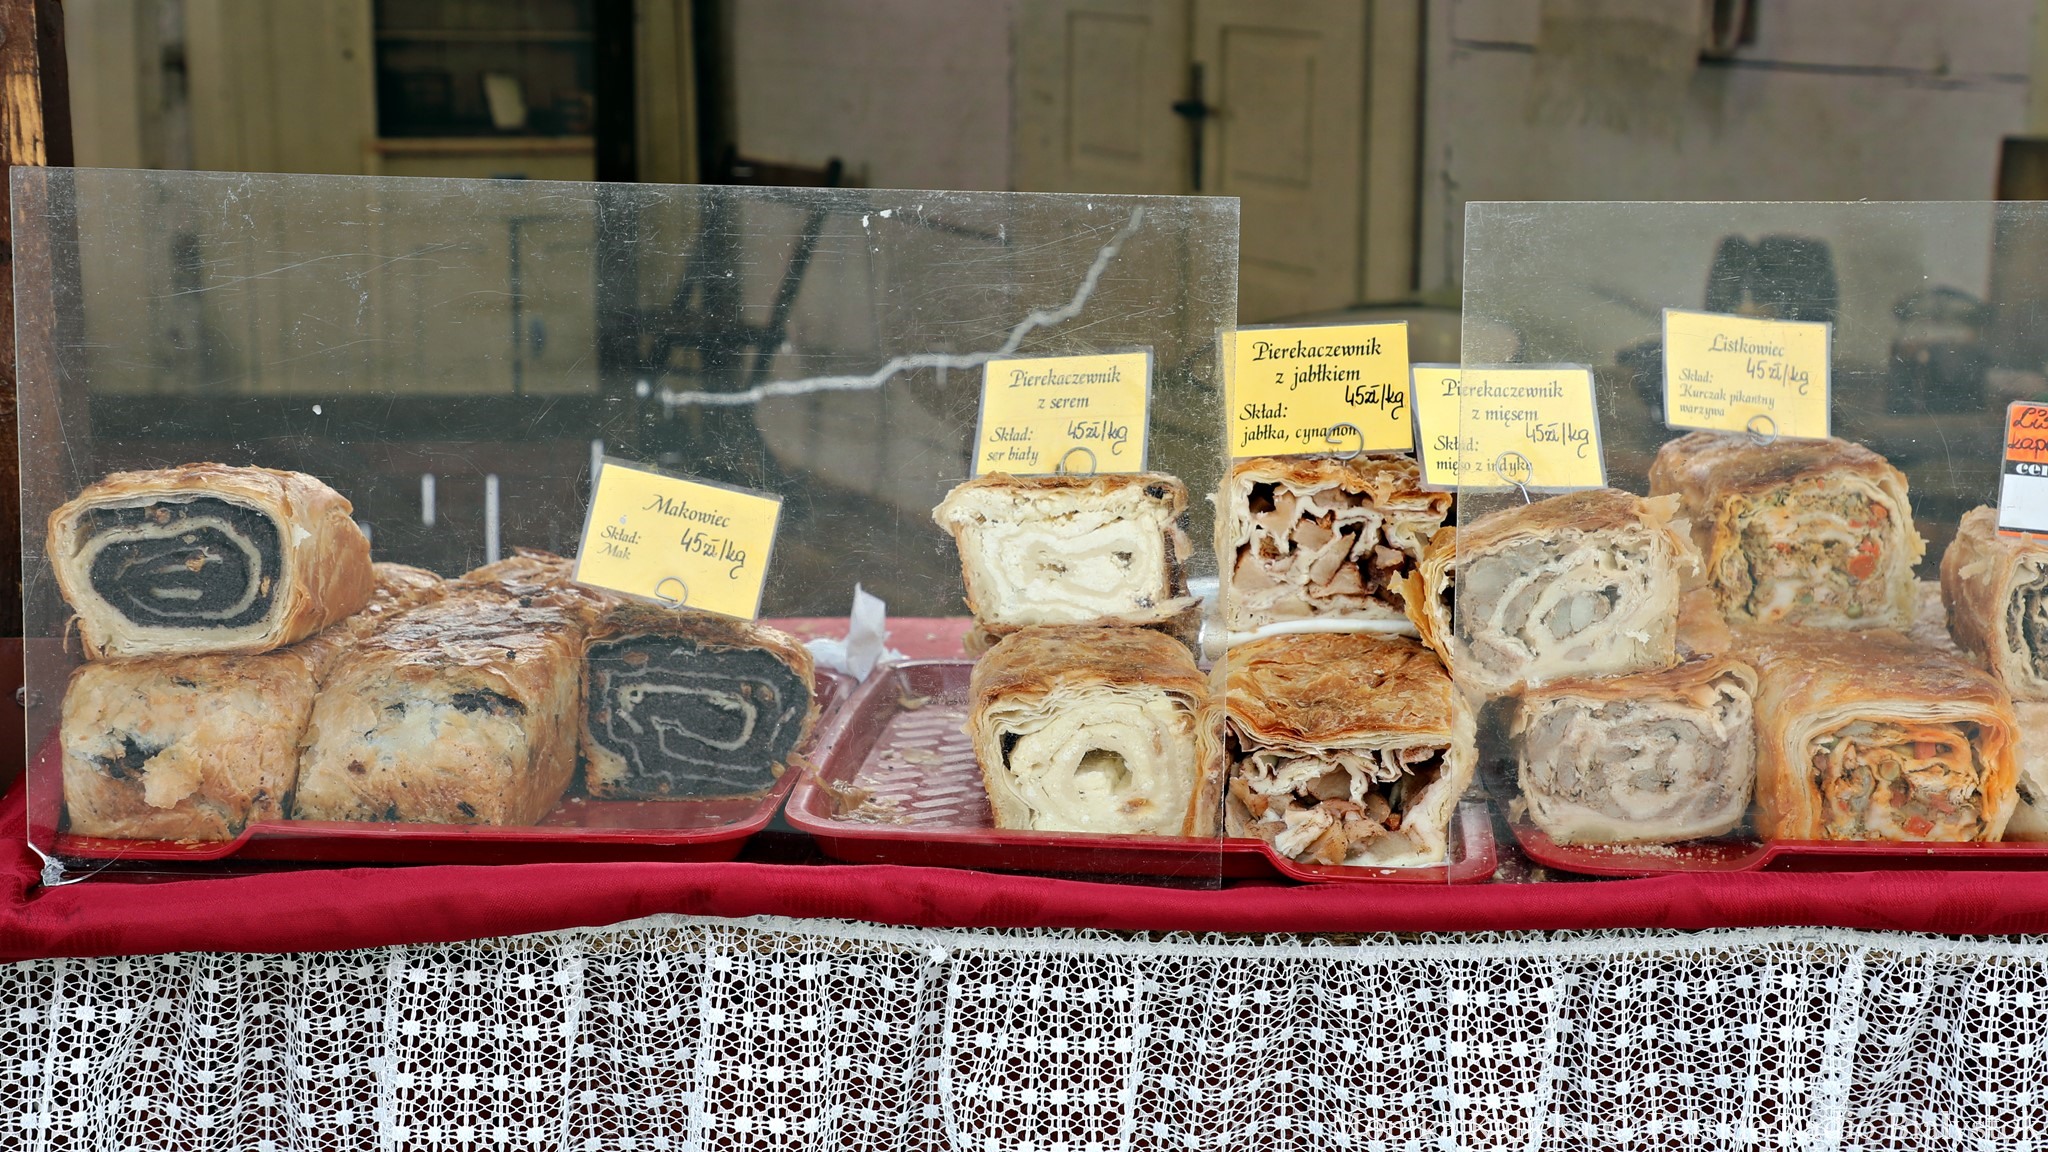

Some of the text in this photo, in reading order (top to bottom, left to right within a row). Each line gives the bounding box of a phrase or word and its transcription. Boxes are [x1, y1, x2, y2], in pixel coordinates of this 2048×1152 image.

[1252, 337, 1382, 361] Pierekaczewnik
[1708, 333, 1785, 357] Listkowiec
[1009, 366, 1122, 389] Pierekaczewnik
[1275, 364, 1361, 391] z jabłkiem
[1678, 368, 1714, 384] Skład:
[1441, 378, 1564, 398] Pierekaczewnik
[1679, 384, 1775, 409] Kurczak pikantny
[1037, 397, 1090, 409] z serem
[1239, 403, 1288, 421] Skład:
[1680, 404, 1725, 420] warzywa
[1472, 405, 1538, 427] z mięsem
[989, 426, 1034, 442] Skład:
[1241, 424, 1357, 447] jabłka, cynamon
[987, 446, 1039, 466] ser biały
[1475, 460, 1483, 471] z
[642, 494, 731, 528] Makowiec
[600, 525, 642, 545] Skład:
[597, 542, 631, 560] Mak
